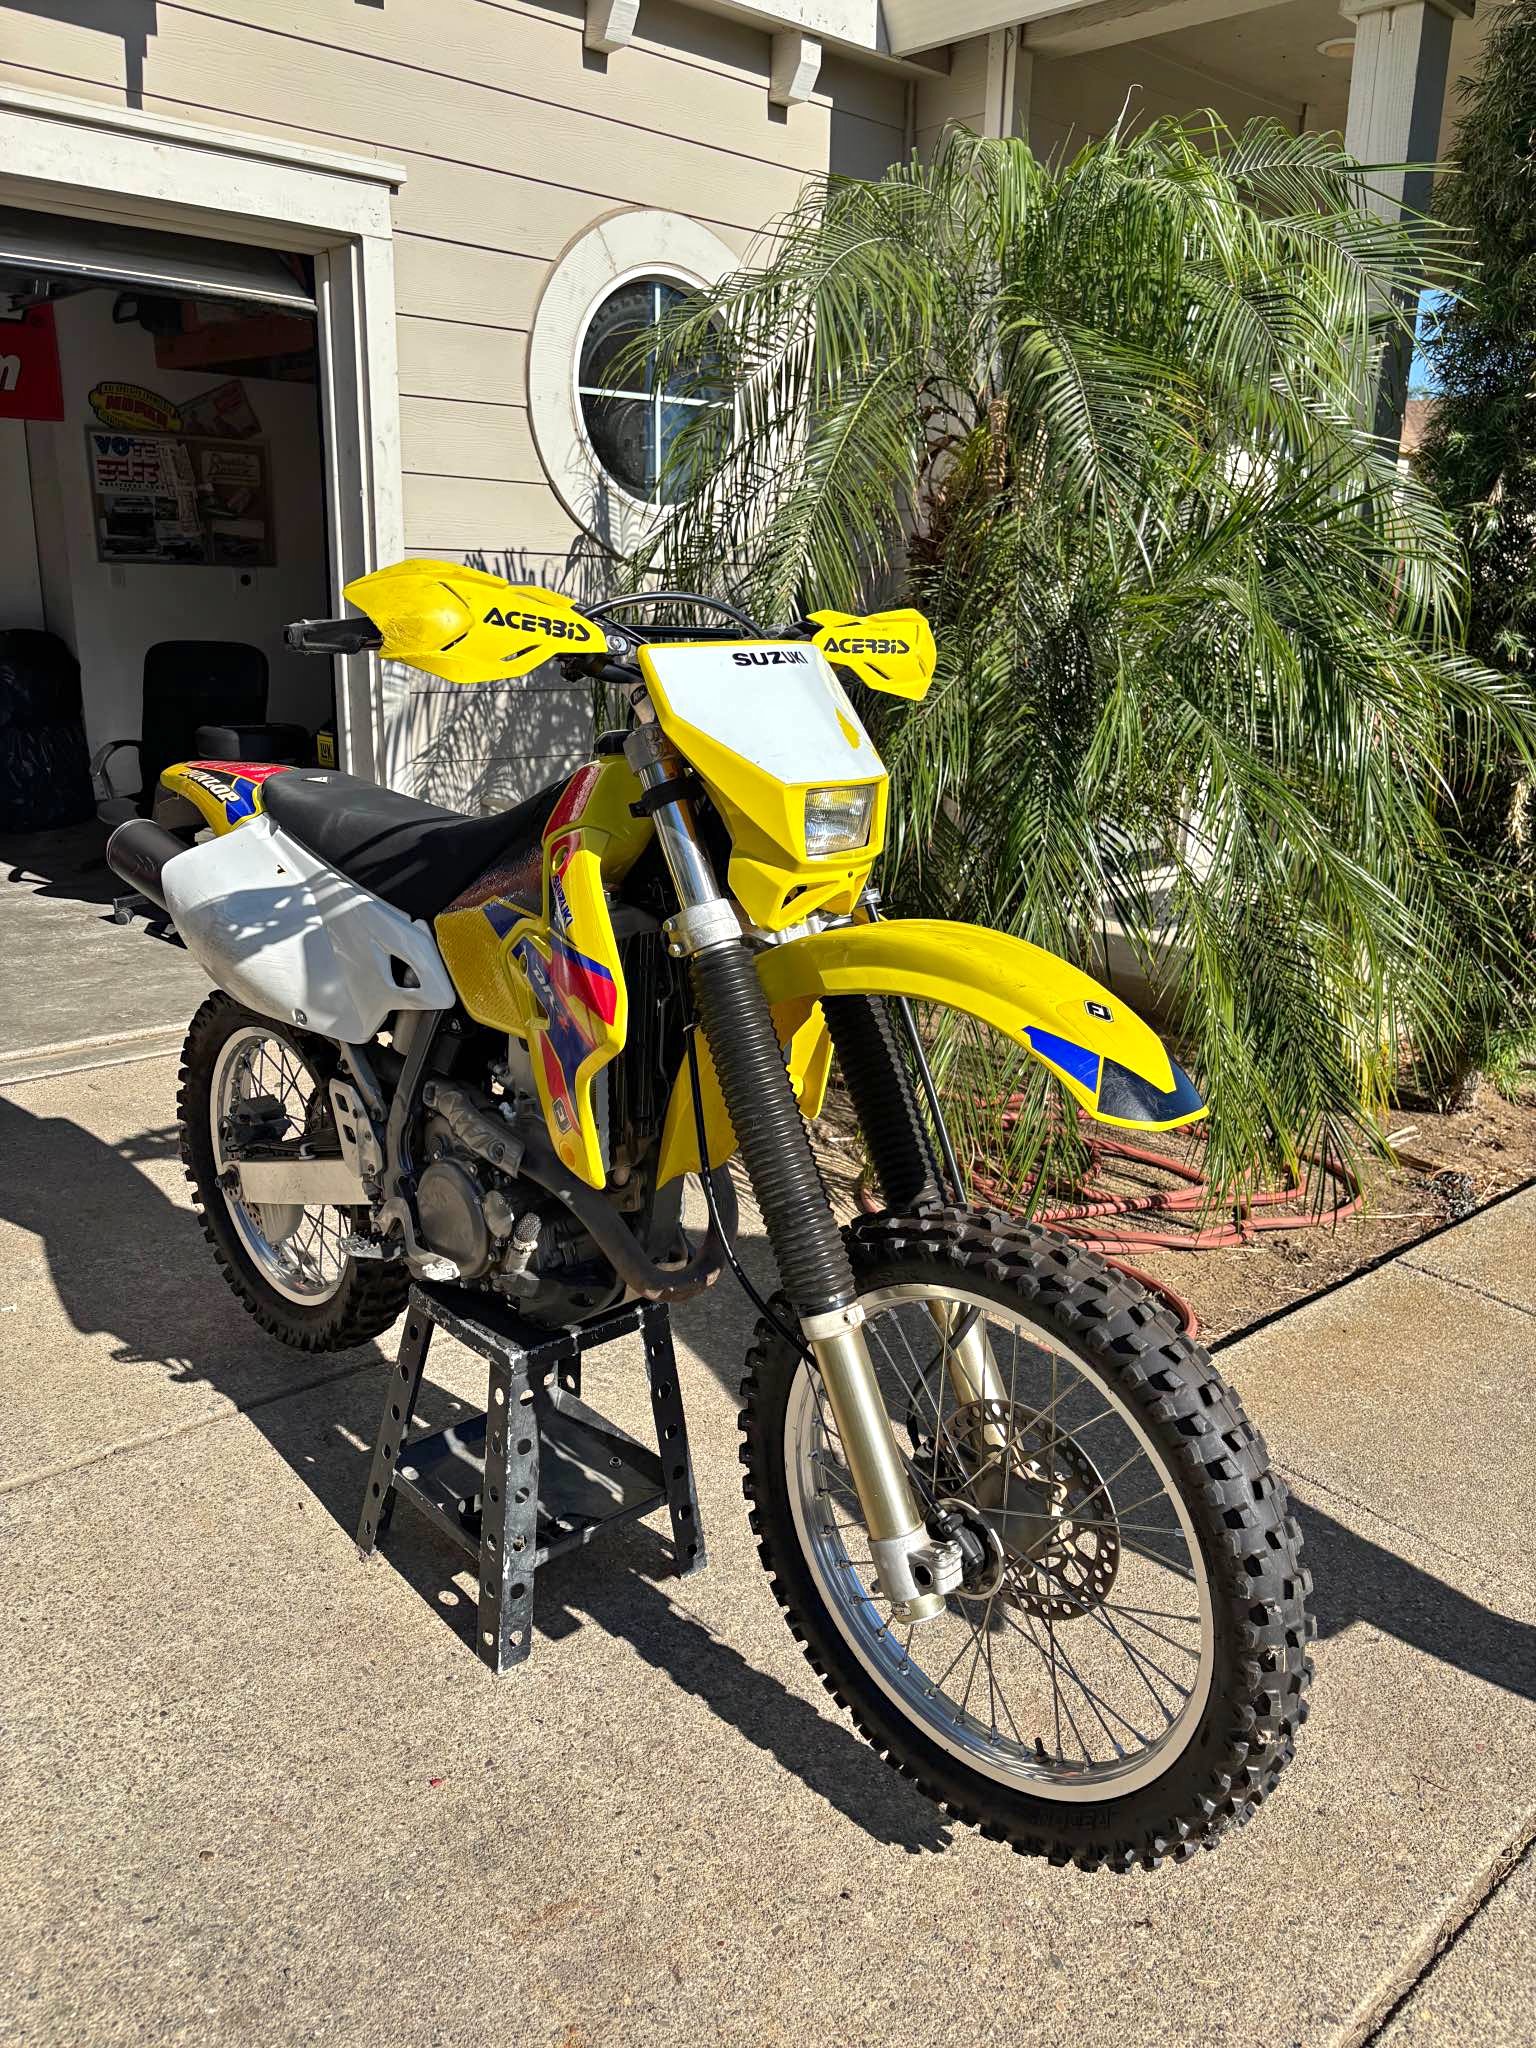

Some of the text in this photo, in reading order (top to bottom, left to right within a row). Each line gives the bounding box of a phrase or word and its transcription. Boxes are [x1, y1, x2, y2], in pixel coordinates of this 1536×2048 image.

[94, 435, 160, 457] VOTE
[732, 651, 808, 667] SUZUKI
[552, 874, 574, 928] SUZUKI
